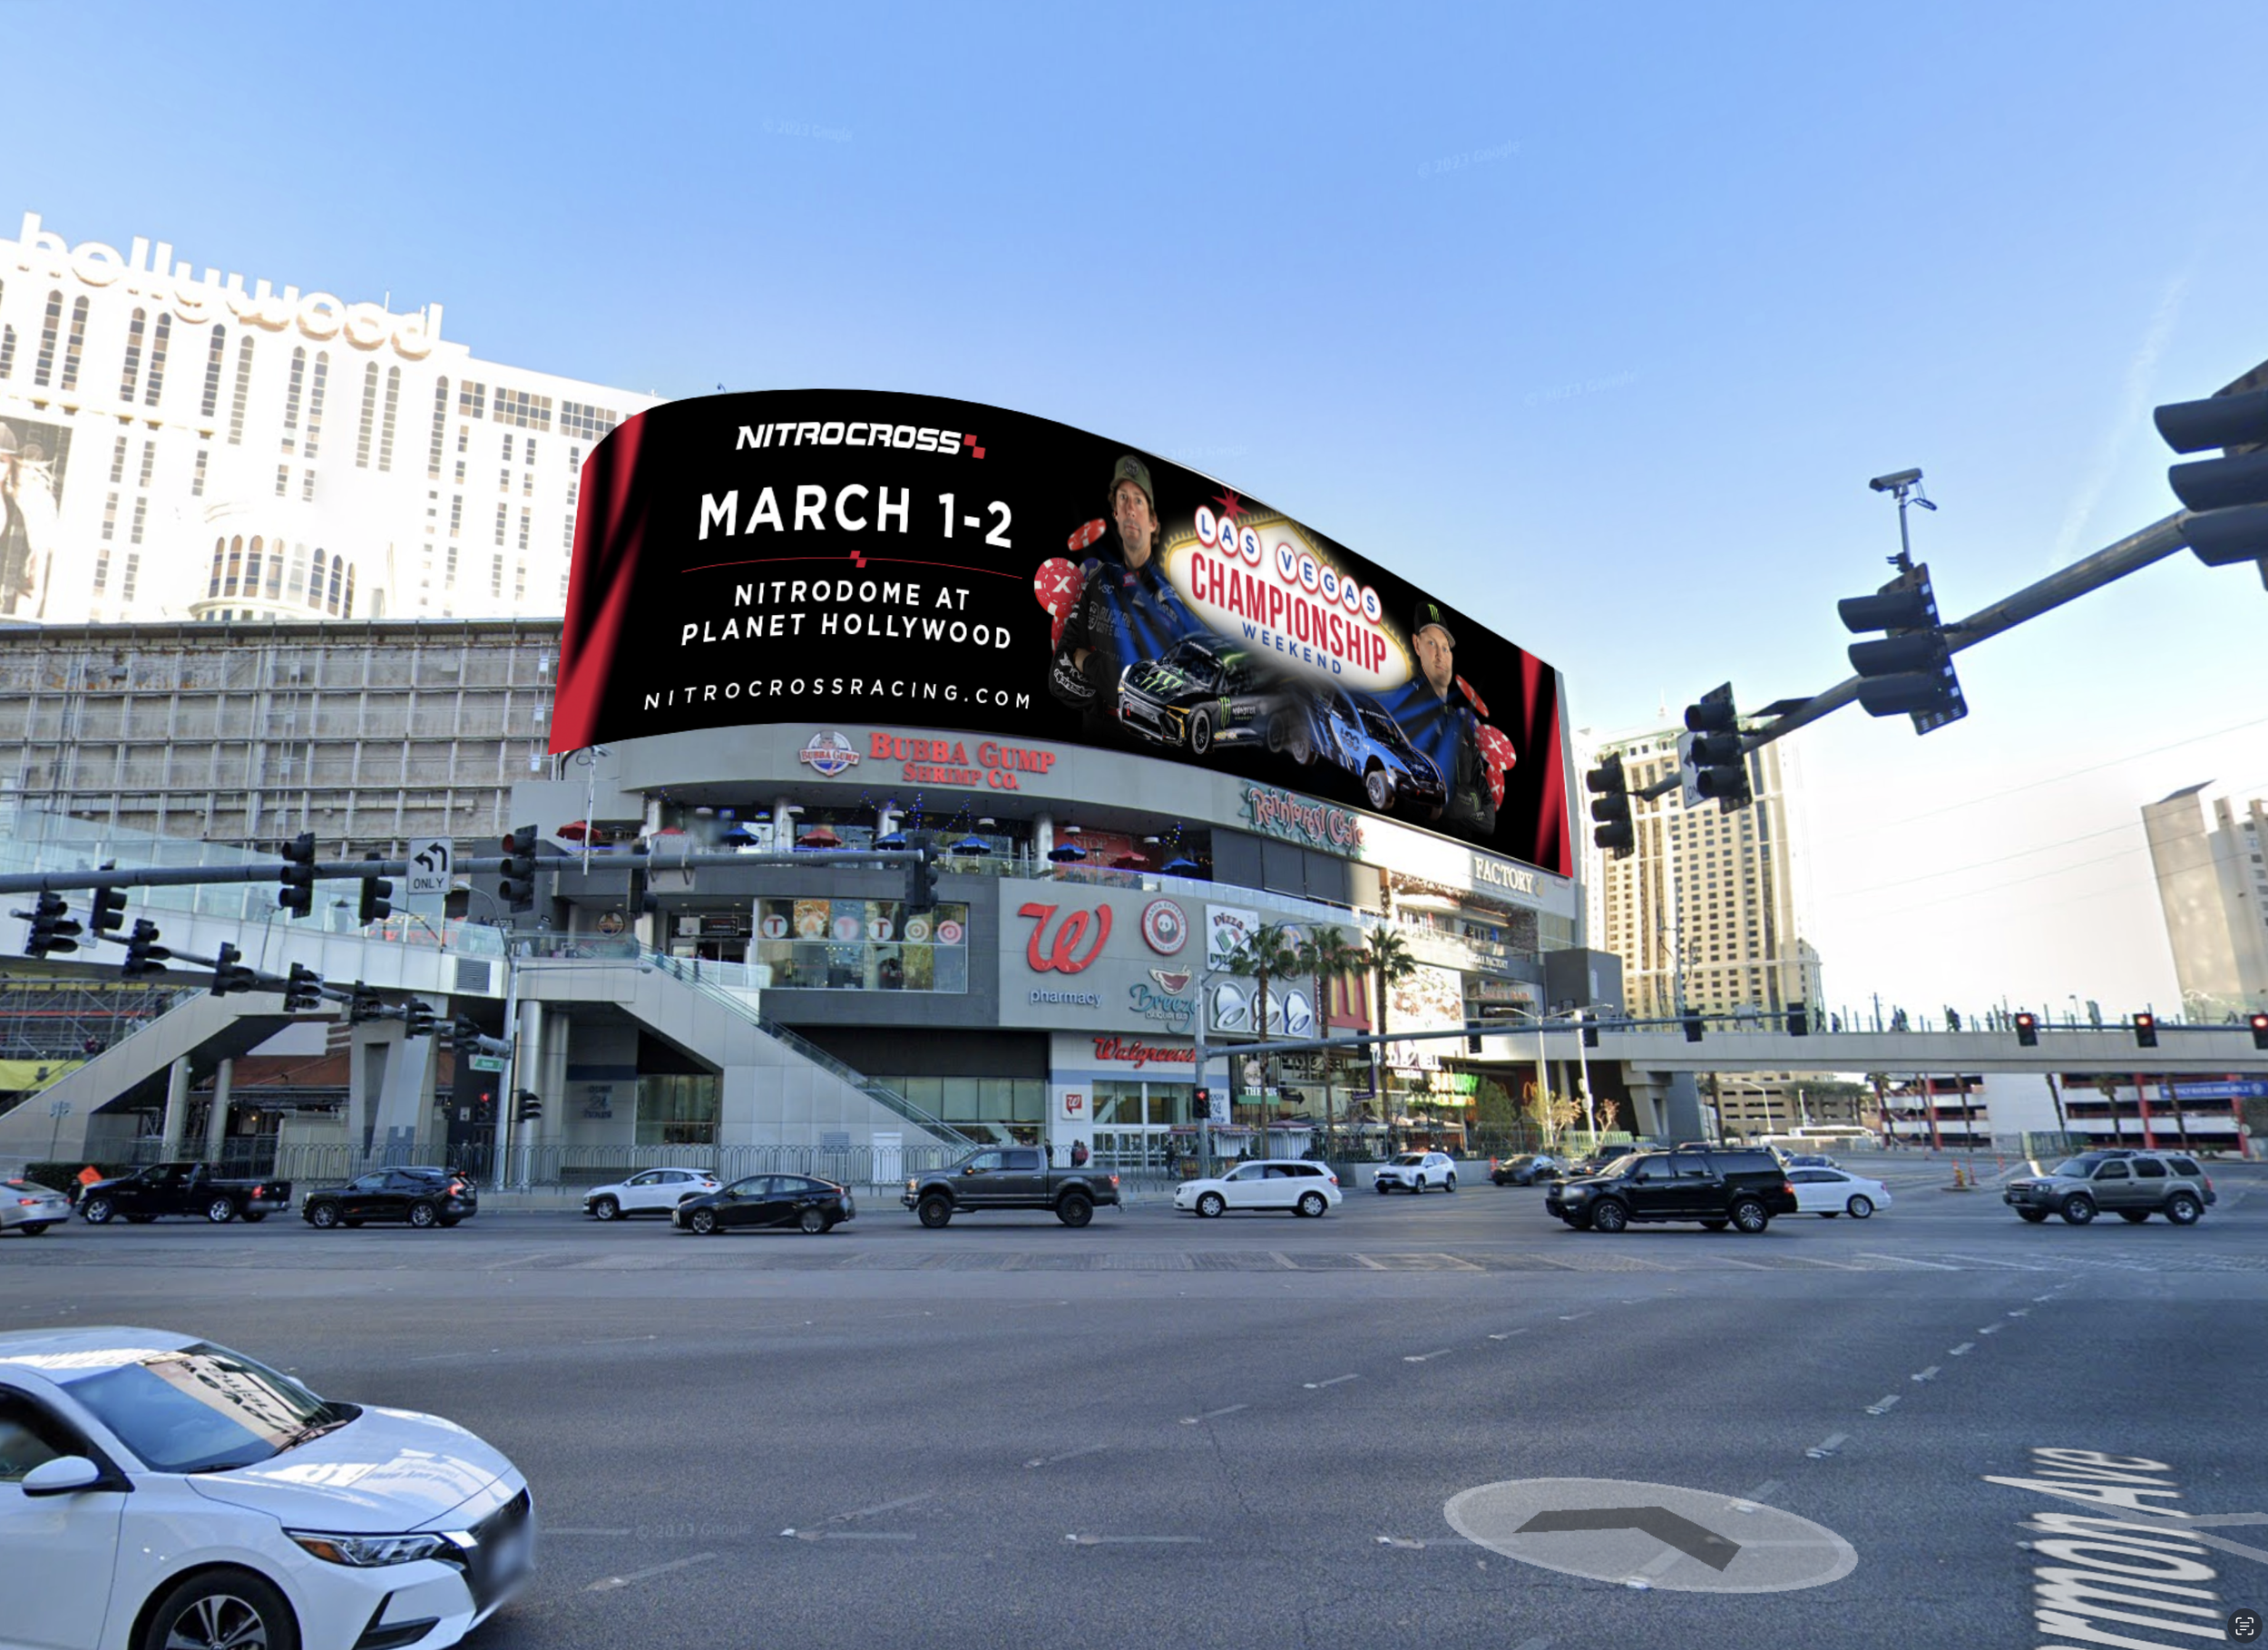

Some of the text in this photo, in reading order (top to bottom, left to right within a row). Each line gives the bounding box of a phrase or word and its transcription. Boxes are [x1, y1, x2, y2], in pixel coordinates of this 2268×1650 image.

[19, 211, 443, 361] hollywood
[736, 422, 962, 454] NITROCROSS
[698, 483, 1012, 549] MARCH 1-2
[1199, 512, 1376, 615] LAS VEGAS
[735, 581, 969, 610] NITRODOME AT
[1191, 552, 1386, 674] CHAMPIONSHIP
[681, 612, 1011, 649] PLANET HOLLYWOOD
[1242, 621, 1342, 674] WEEKEND
[644, 678, 1030, 710] NITROCROSSRACING.COM
[801, 749, 859, 765] BUBBA GUMP
[868, 732, 1056, 774] BUBBA GUMP
[903, 762, 982, 786] SHRIMP
[1248, 787, 1326, 841] Rainforest
[414, 877, 445, 890] ONLY
[1474, 856, 1534, 894] FACTORY
[1213, 912, 1245, 931] Pizza
[1030, 989, 1103, 1010] pharmacy
[1094, 1037, 1196, 1069] Walgreens
[1244, 1087, 1262, 1097] THE
